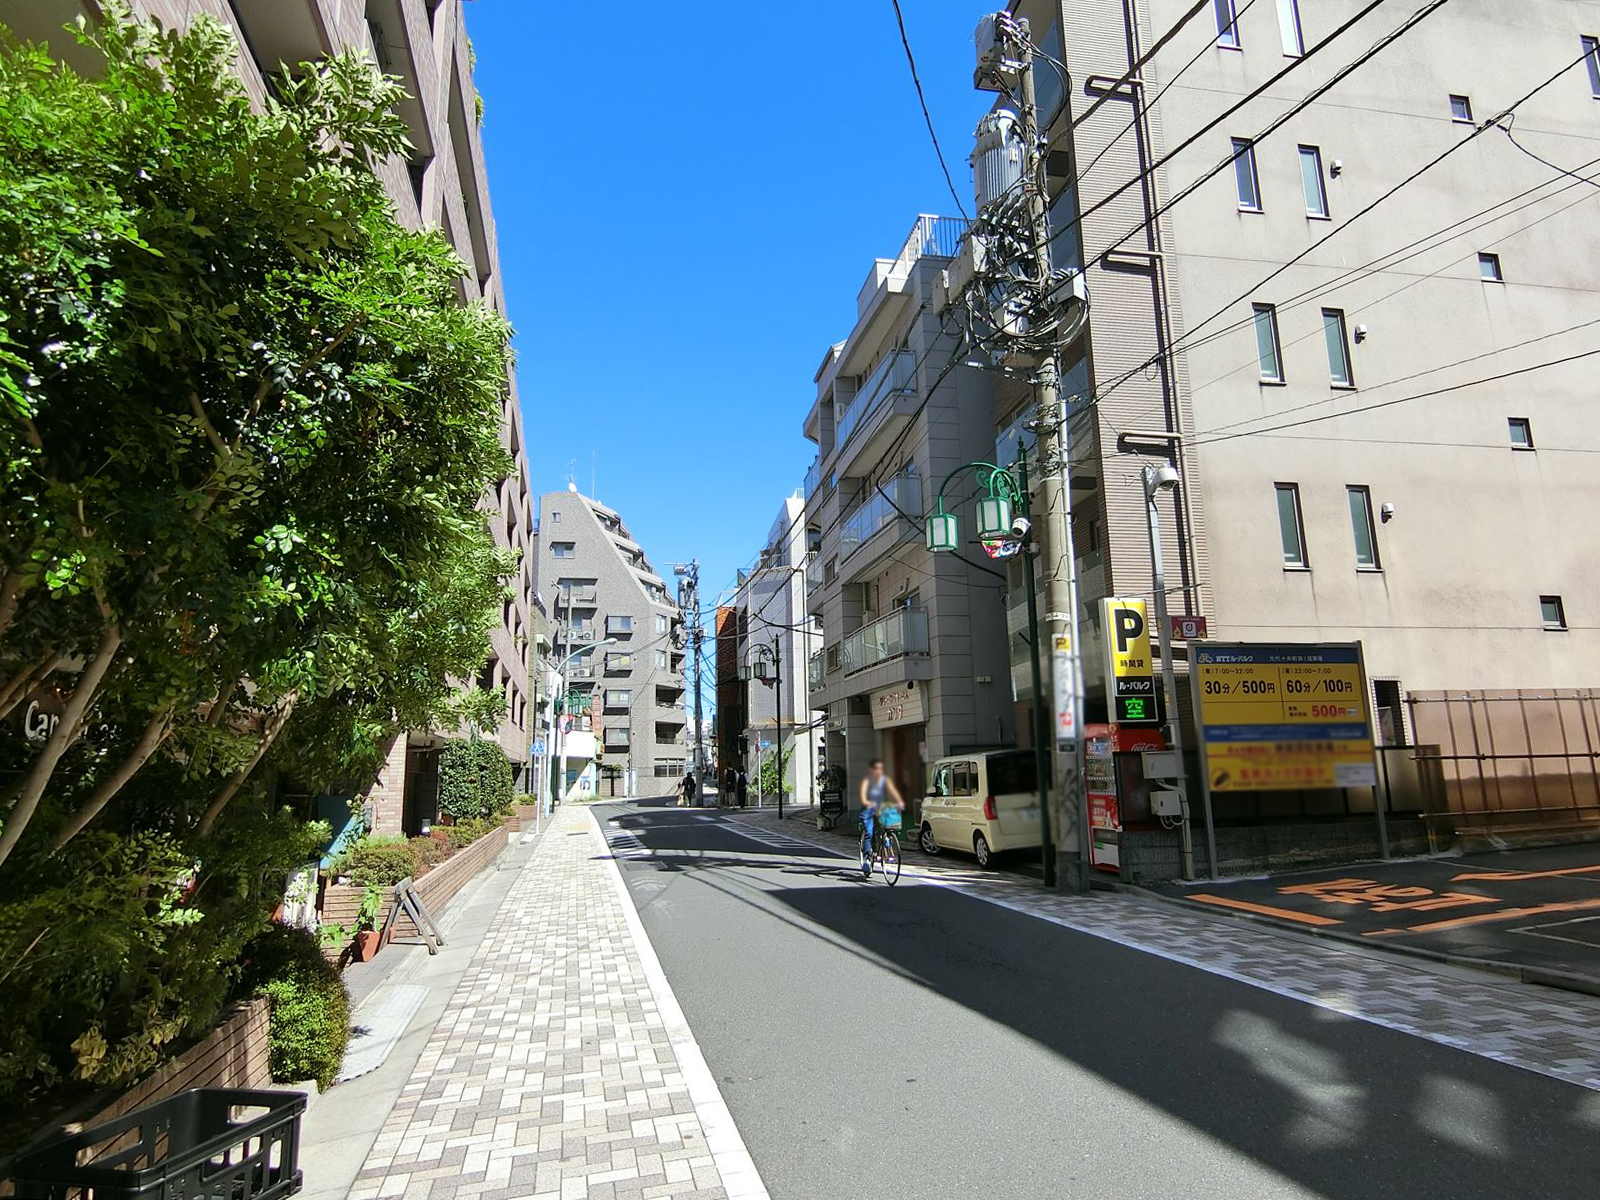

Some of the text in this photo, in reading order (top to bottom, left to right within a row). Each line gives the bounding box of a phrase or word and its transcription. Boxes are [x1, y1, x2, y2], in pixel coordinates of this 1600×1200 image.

[1114, 609, 1144, 652] P
[1120, 659, 1144, 668] 時間貸
